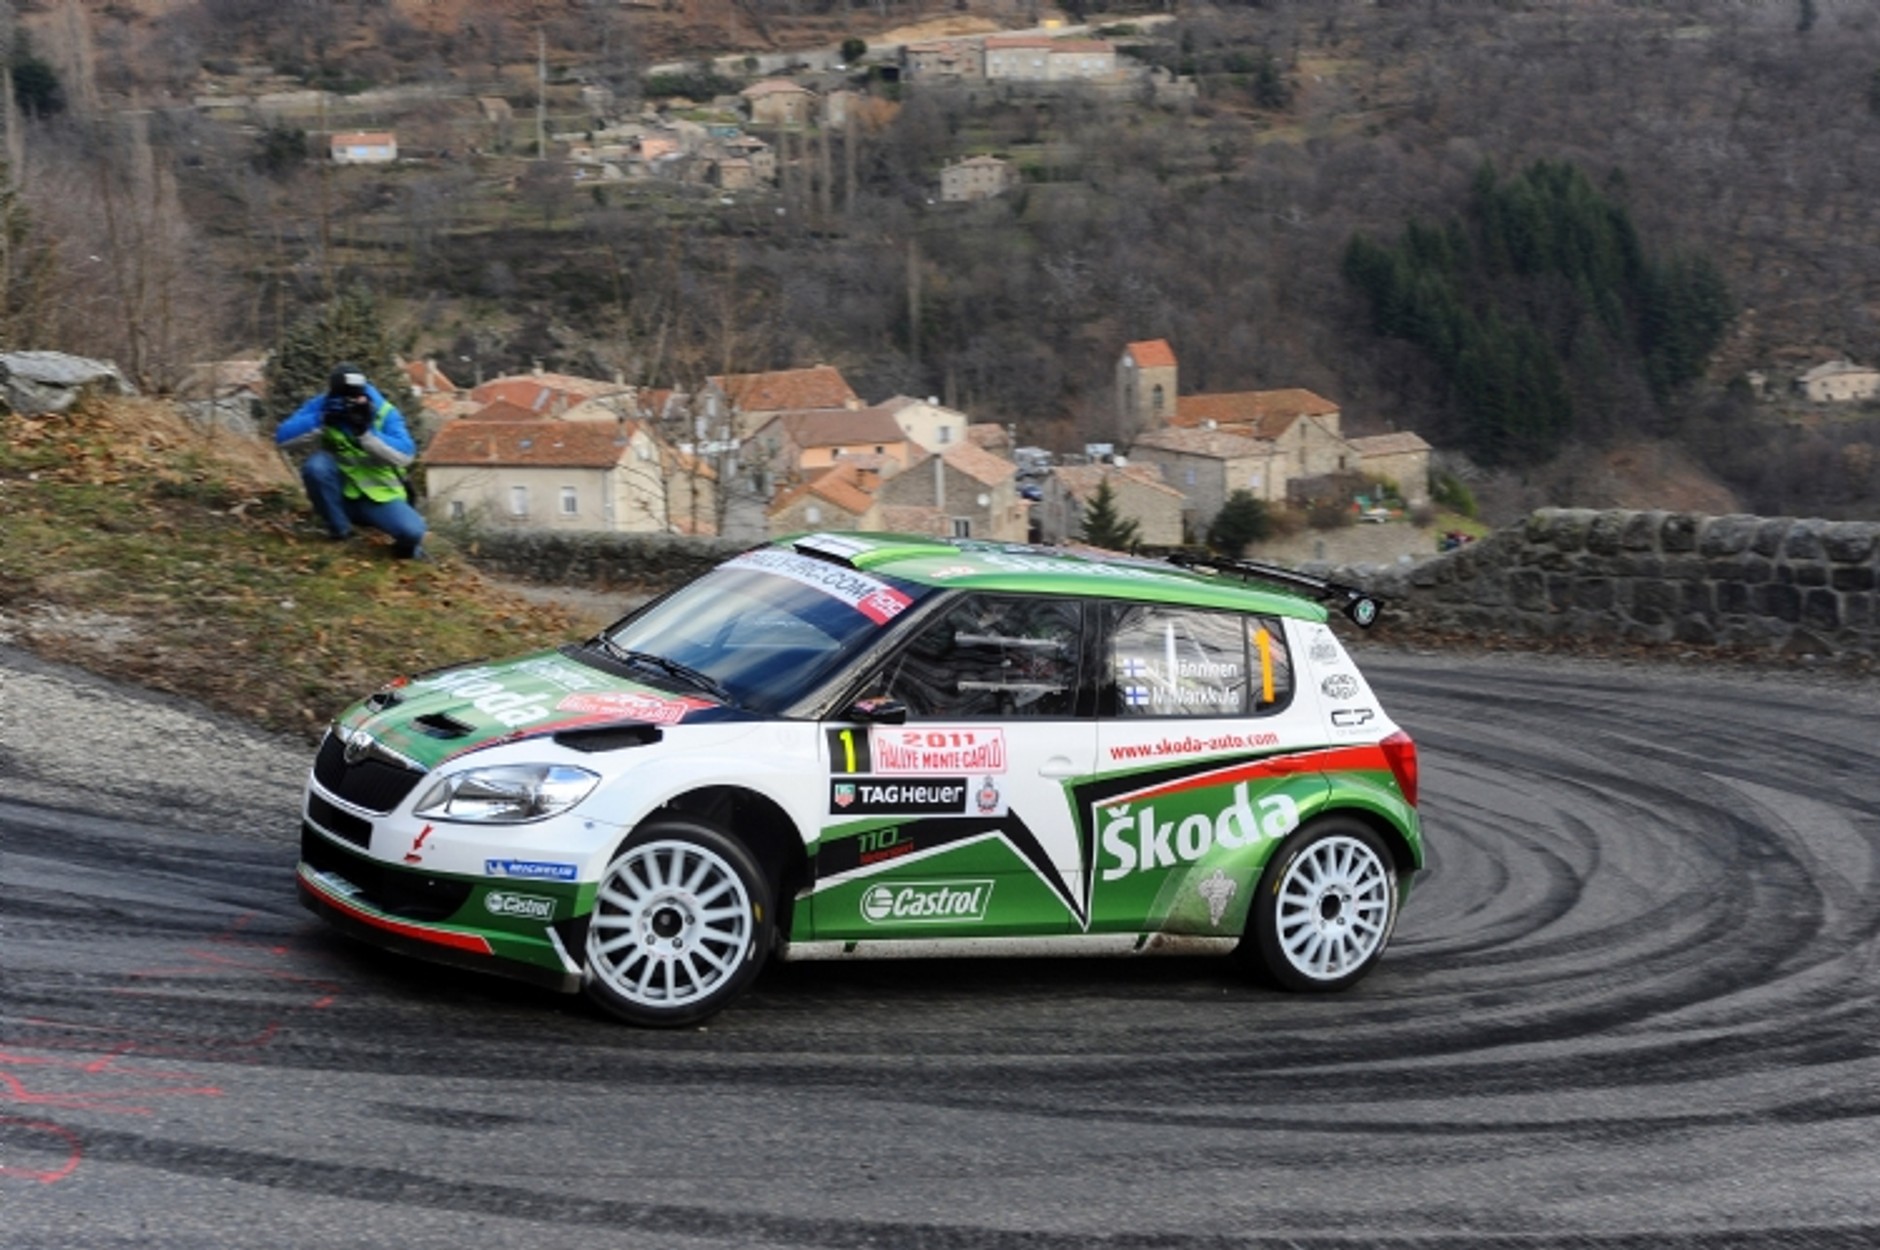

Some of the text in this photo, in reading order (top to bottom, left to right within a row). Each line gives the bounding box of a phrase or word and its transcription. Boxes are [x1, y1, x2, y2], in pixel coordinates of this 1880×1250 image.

[839, 729, 856, 774] 1
[878, 738, 1001, 769] RALLYE MONTE CARLO
[902, 733, 975, 748] 2011
[1110, 732, 1279, 760] www.skoda-auto.com
[1101, 781, 1300, 882] Škoda
[508, 864, 573, 876] MICHELIN
[503, 897, 551, 916] Castrol
[893, 886, 983, 919] Castrol
